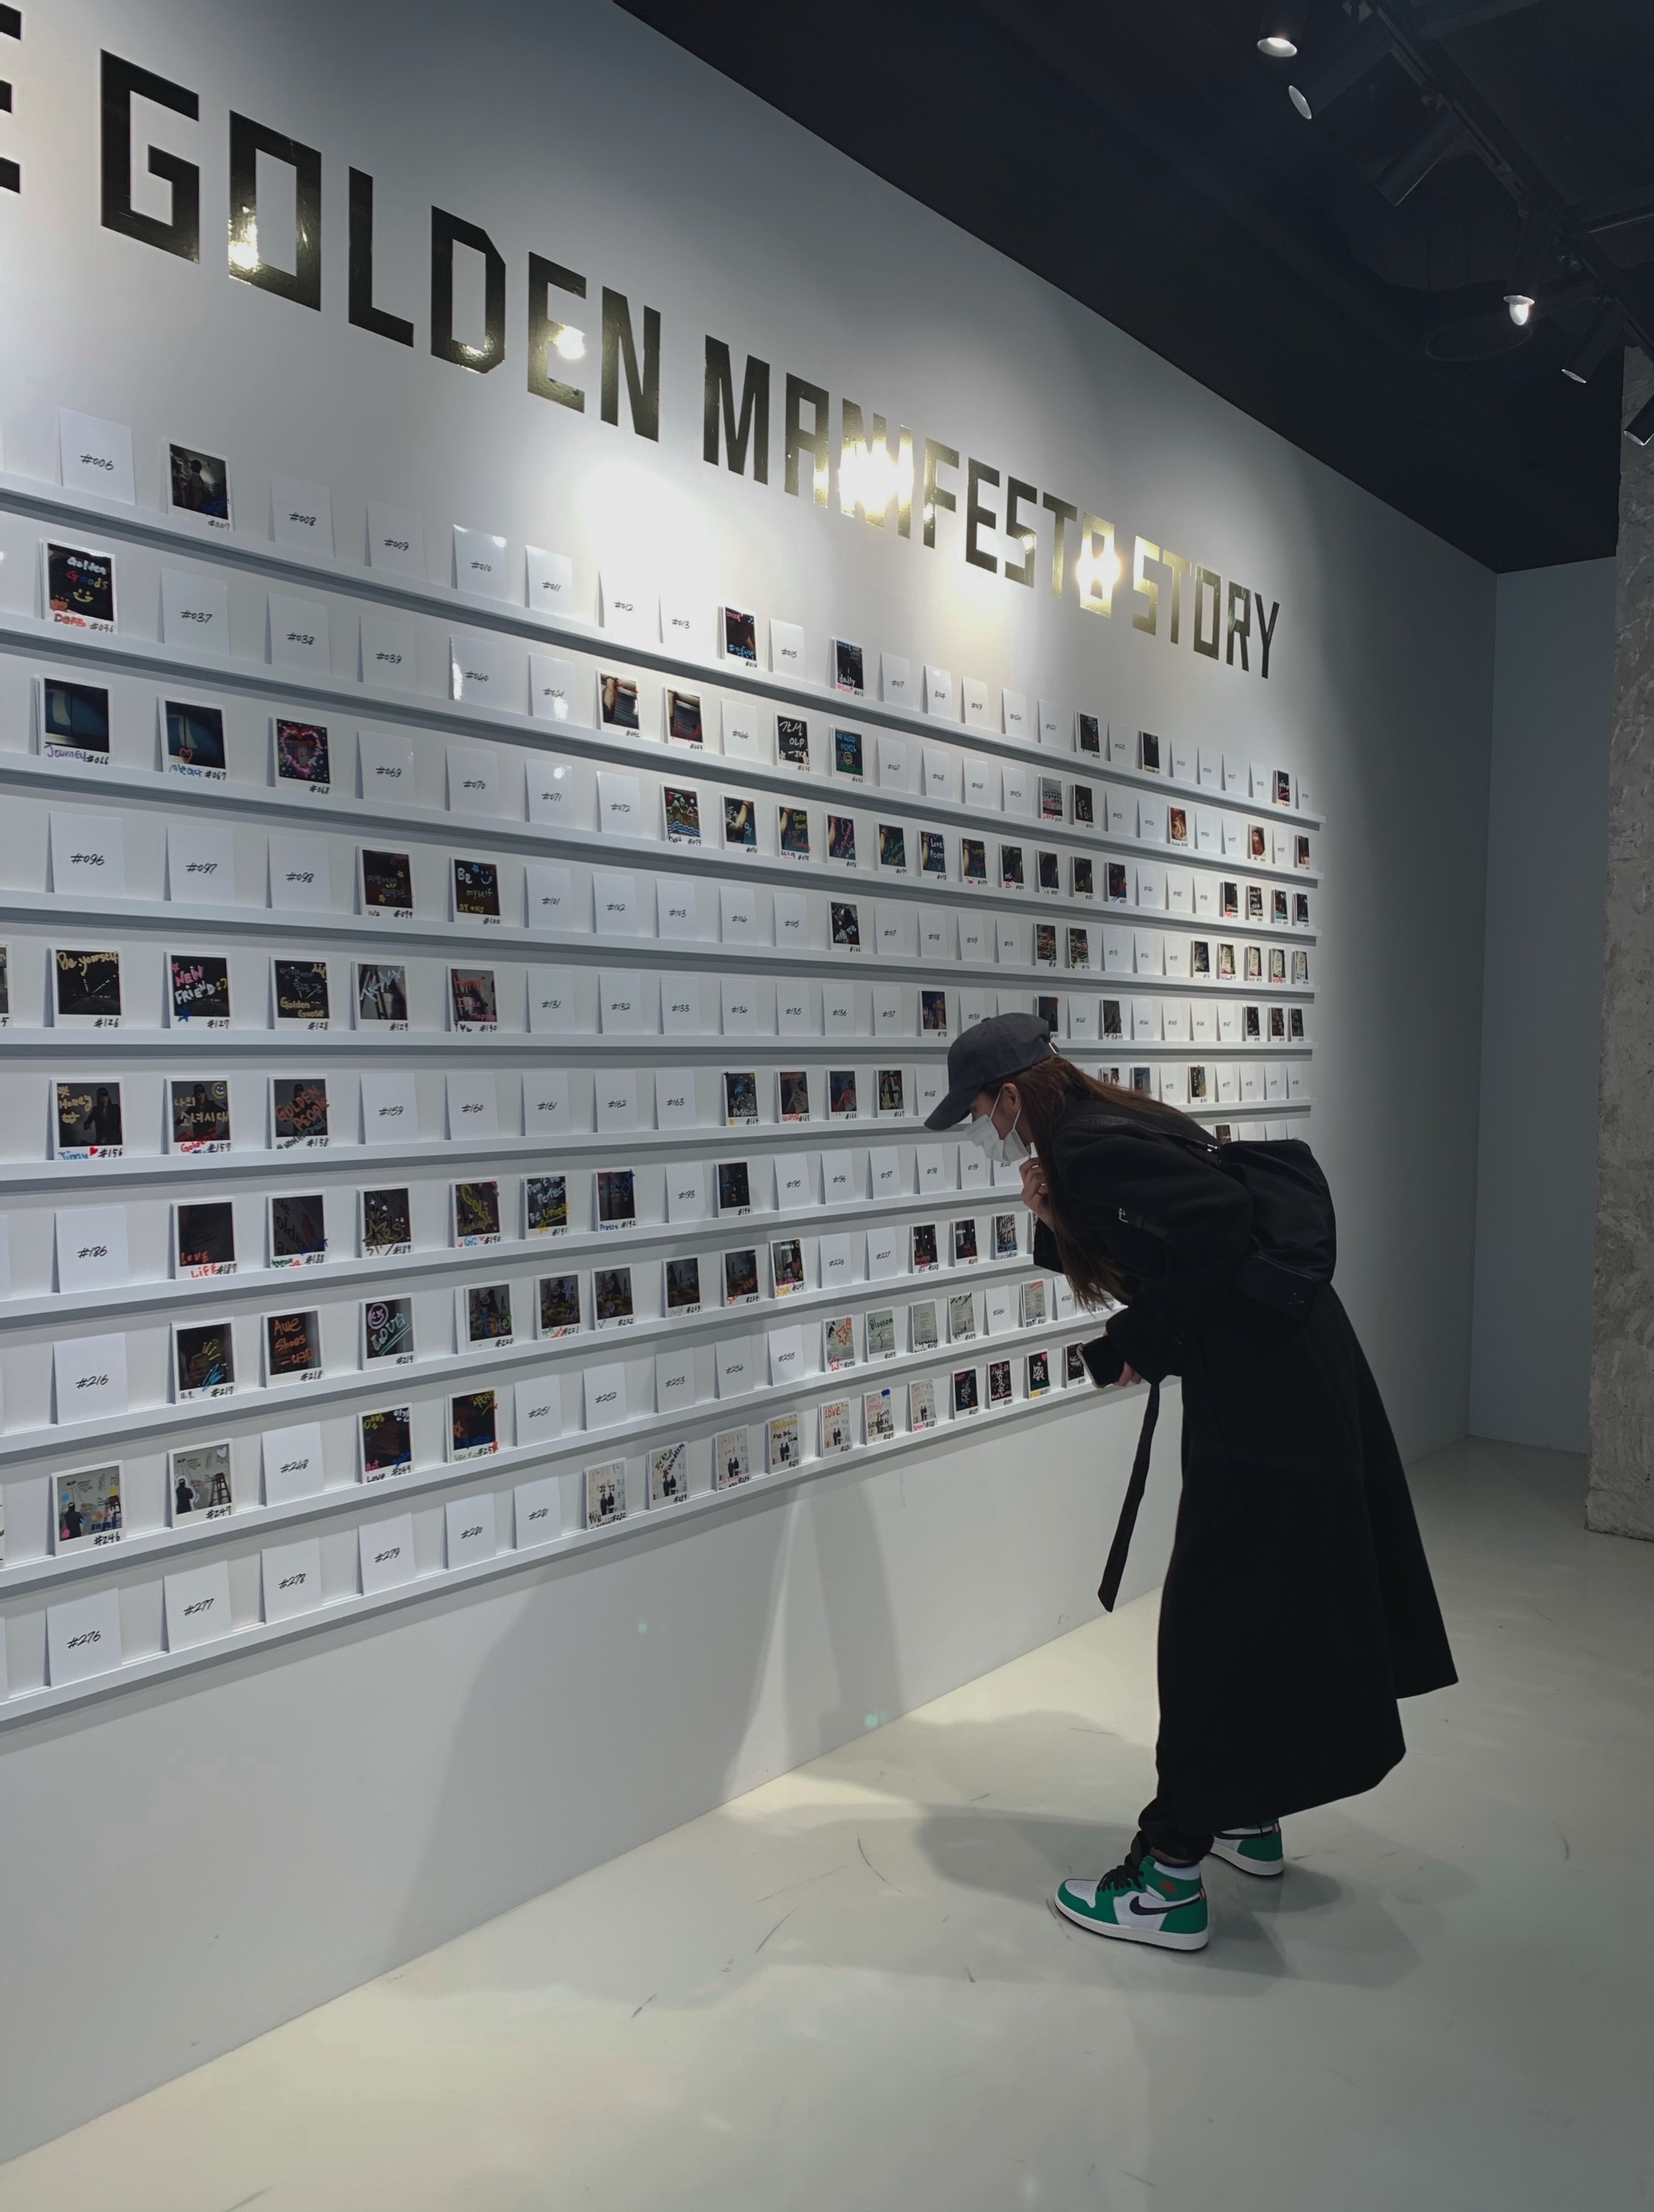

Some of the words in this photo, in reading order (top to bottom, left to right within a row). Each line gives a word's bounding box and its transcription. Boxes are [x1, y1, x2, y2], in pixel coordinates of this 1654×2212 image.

[100, 49, 661, 443] GOLDEN
[703, 334, 1116, 619] MANIFESTO
[1132, 535, 1280, 679] STORY
[80, 454, 114, 471] #006
[289, 513, 316, 526] #008
[383, 539, 409, 551] #009
[470, 561, 492, 572] #010
[66, 570, 109, 590] Goods
[542, 581, 560, 592] #011
[614, 601, 633, 611] #012
[181, 610, 212, 623] #037
[672, 618, 689, 628] #013
[287, 633, 314, 645] #038
[376, 652, 402, 664] #039
[781, 648, 797, 658] #015
[465, 671, 488, 682] #040
[839, 668, 856, 687] daily
[376, 766, 401, 777] #069
[463, 780, 485, 789] #070
[541, 792, 562, 802] #071
[611, 803, 630, 812] #072
[71, 853, 104, 866] #096
[186, 863, 218, 874] #097
[286, 873, 314, 883] #098
[542, 897, 560, 905] #101
[607, 904, 625, 912] #102
[669, 909, 686, 918] #103
[732, 915, 747, 923] #104
[542, 1000, 561, 1008] #131
[611, 1002, 630, 1010] #132
[94, 1018, 119, 1027] #126
[207, 1019, 229, 1027] #127
[174, 1097, 196, 1107] 나의
[538, 1102, 557, 1110] #161
[608, 1100, 626, 1108] #162
[378, 1106, 403, 1116] #159
[462, 1104, 483, 1113] #160
[180, 1110, 229, 1126] 소녀시대
[98, 1148, 122, 1157] #156
[786, 1180, 801, 1188] #195
[678, 1190, 695, 1199] #193
[552, 1227, 567, 1235] #191
[600, 1223, 619, 1231] Pretty
[77, 1246, 107, 1258] #186
[876, 1251, 891, 1259] #227
[829, 1258, 844, 1266] #226
[869, 1317, 894, 1331] Blossom
[370, 1312, 408, 1351] LOVE
[778, 1352, 795, 1362] #255
[726, 1365, 743, 1374] #254
[76, 1375, 108, 1389] #216
[665, 1376, 685, 1387] #253
[210, 1386, 234, 1397] #217
[595, 1392, 616, 1404] #252
[528, 1407, 550, 1418] #251
[280, 1459, 308, 1473] #248
[206, 1506, 231, 1519] #247
[529, 1508, 549, 1520] #281
[461, 1527, 483, 1539] #280
[93, 1533, 119, 1545] #246
[375, 1547, 400, 1563] #279
[279, 1573, 306, 1589] #278
[184, 1598, 214, 1616] #277
[67, 1631, 100, 1648] #276
